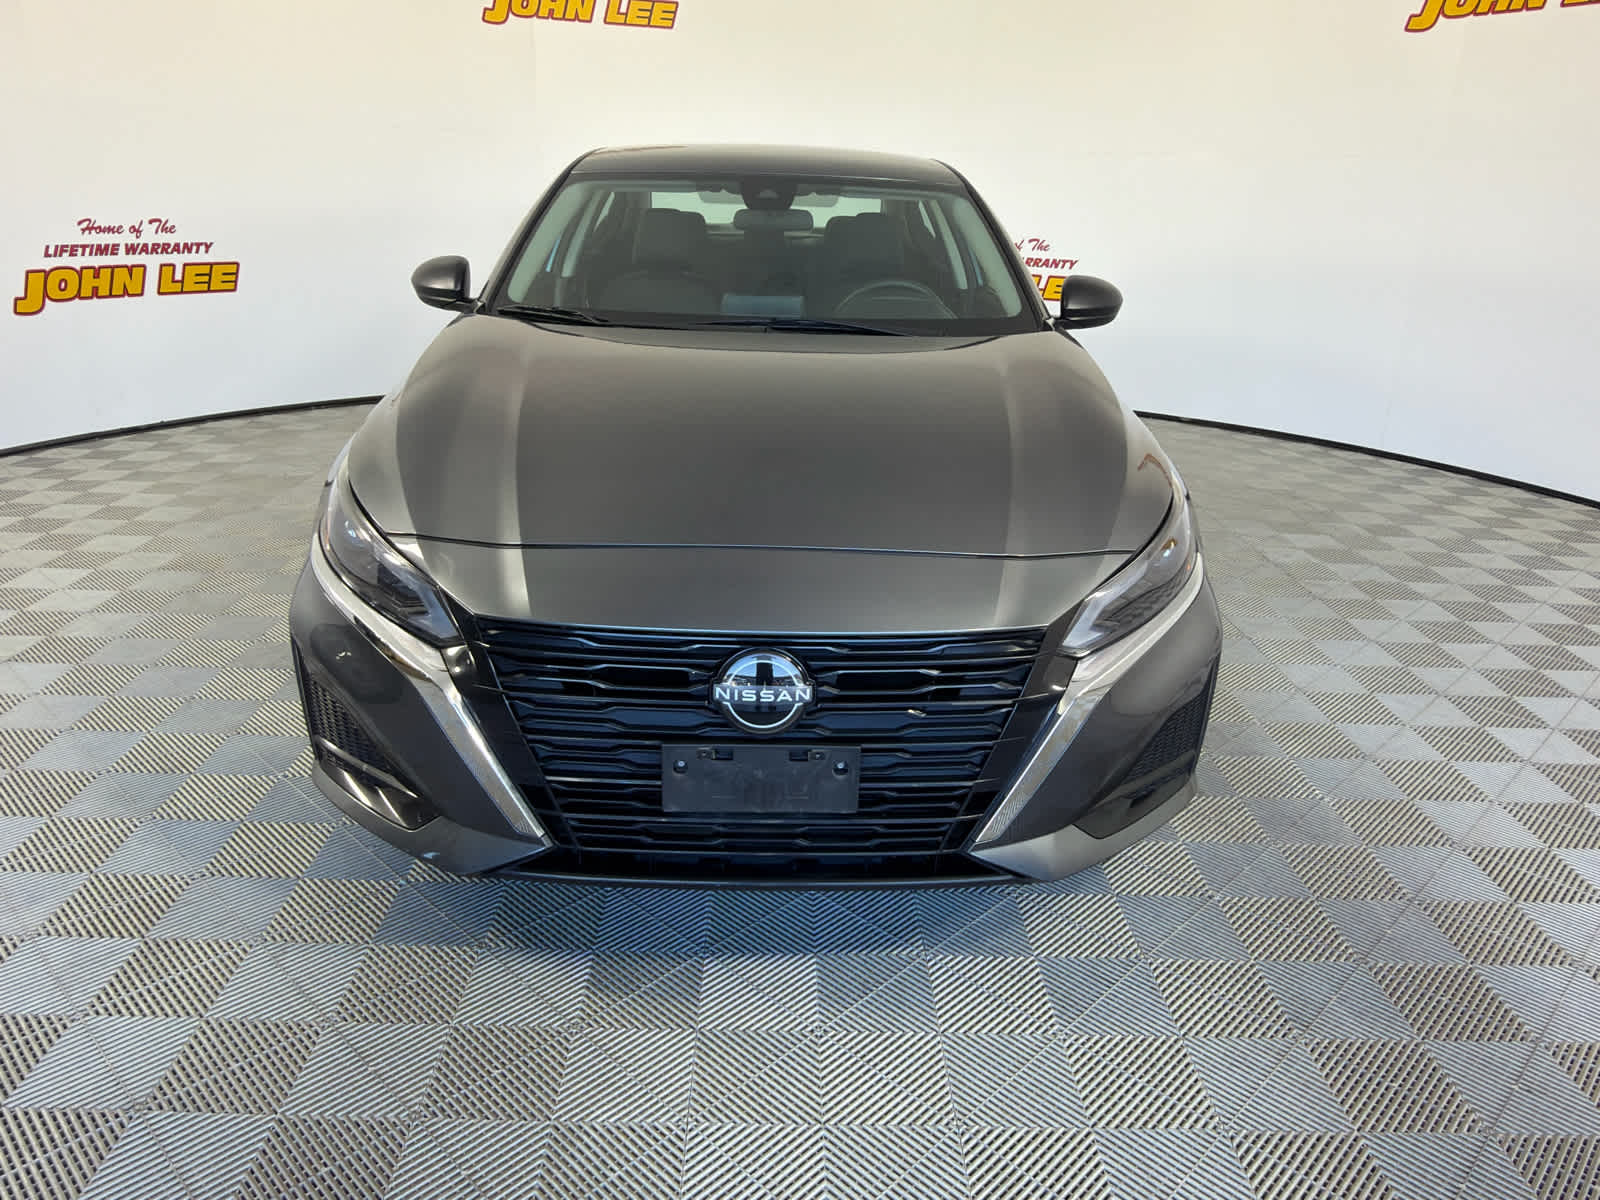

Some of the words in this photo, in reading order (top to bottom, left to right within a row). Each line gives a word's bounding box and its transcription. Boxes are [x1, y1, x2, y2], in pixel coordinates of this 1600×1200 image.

[604, 0, 680, 29] LEE
[77, 218, 124, 235] Home
[129, 219, 143, 239] of
[149, 218, 176, 234] The
[43, 243, 120, 258] LIFETIME
[124, 241, 214, 256] WARRANTY
[1028, 238, 1050, 252] The
[1025, 257, 1079, 270] RRANTY
[13, 264, 147, 316] JOHN
[157, 261, 240, 295] LEE
[715, 686, 811, 702] NISSAN
